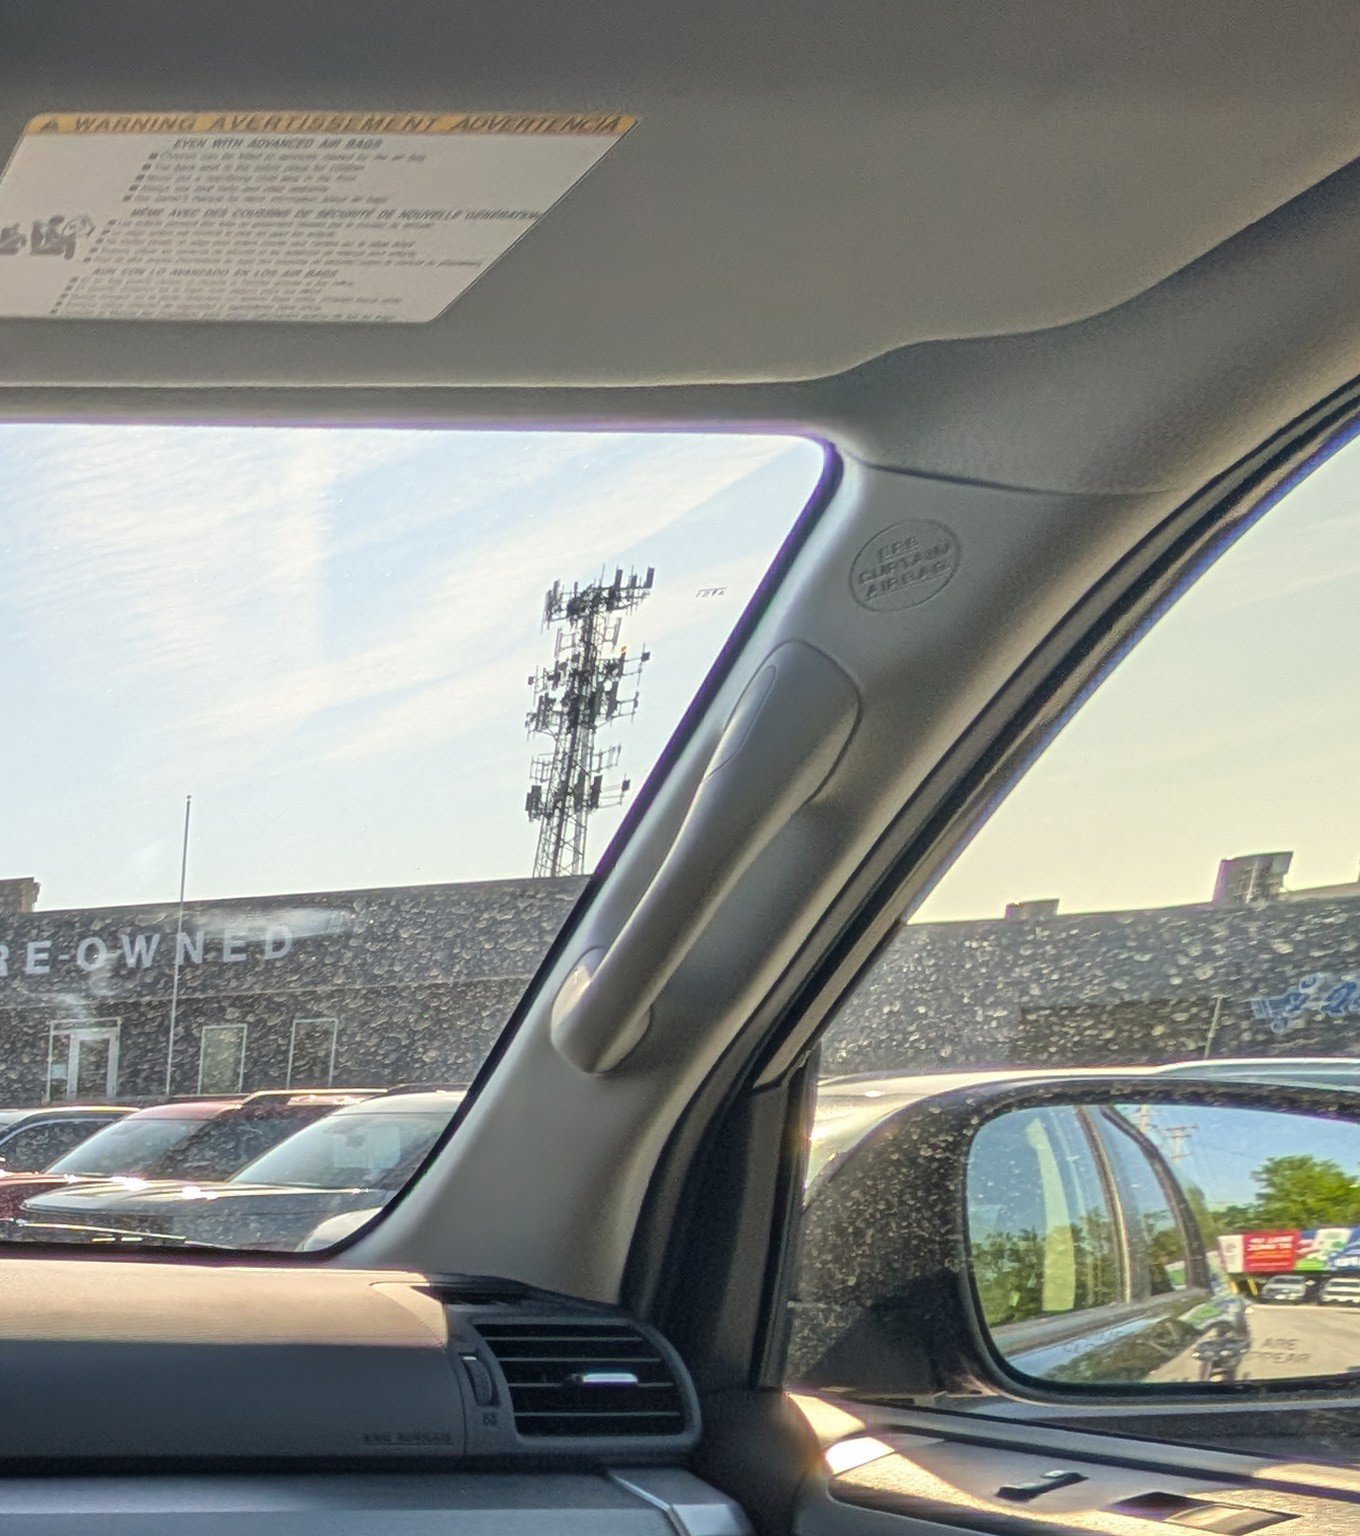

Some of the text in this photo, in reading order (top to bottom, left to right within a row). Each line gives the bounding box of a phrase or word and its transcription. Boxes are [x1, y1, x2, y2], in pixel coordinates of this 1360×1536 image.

[73, 116, 198, 133] WARNING
[208, 116, 438, 133] AVERTISSEMENT
[211, 138, 244, 149] WITH
[246, 138, 316, 150] ADVANCED
